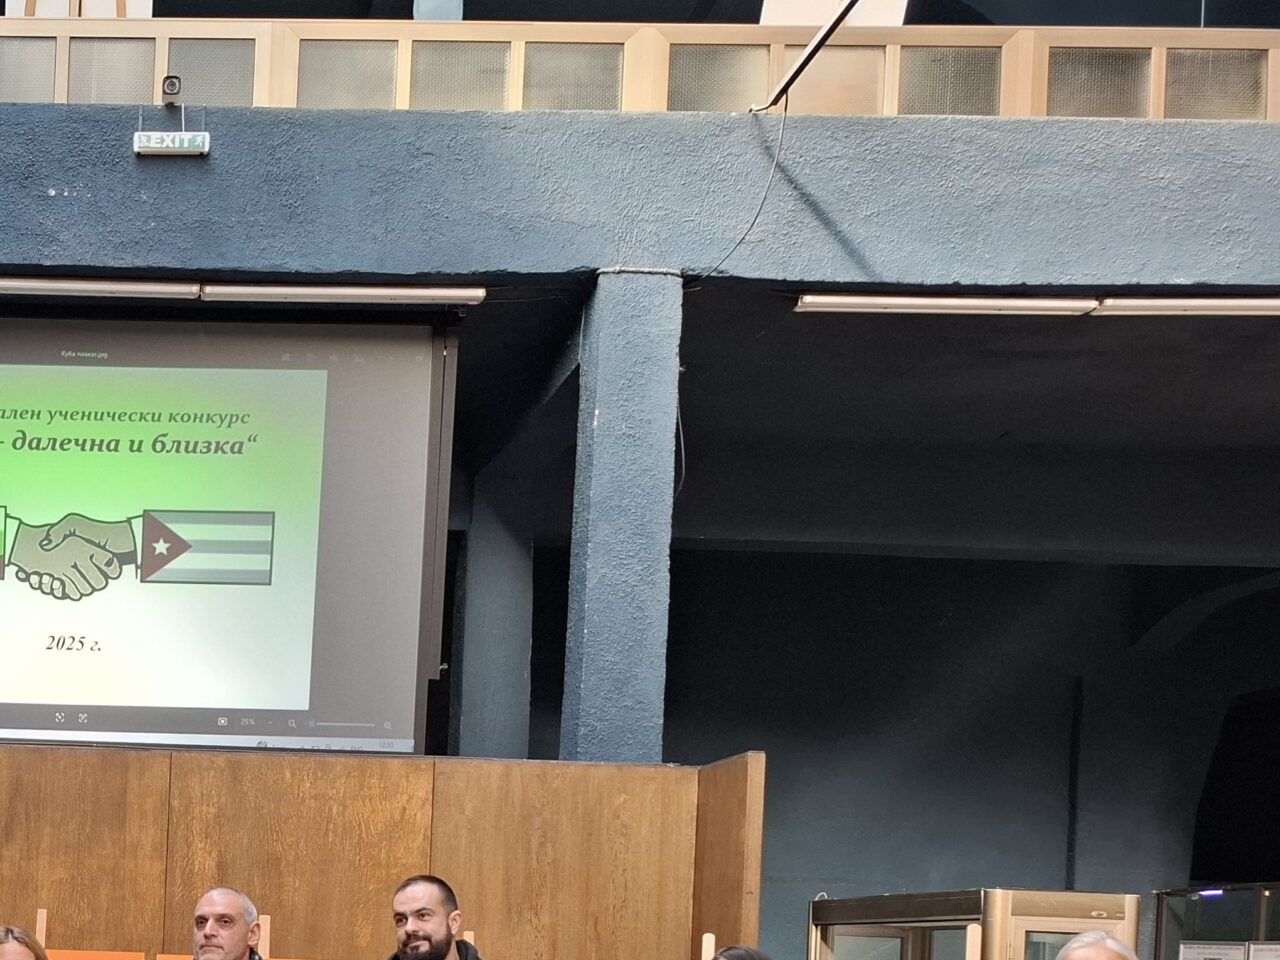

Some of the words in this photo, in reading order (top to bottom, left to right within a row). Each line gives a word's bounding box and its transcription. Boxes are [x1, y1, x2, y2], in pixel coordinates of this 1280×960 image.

[150, 134, 192, 148] EXIT
[46, 408, 162, 425] ученически
[168, 411, 251, 429] конкурс
[11, 429, 121, 453] далечна
[127, 438, 144, 454] и
[45, 635, 86, 651] 2025
[89, 640, 101, 651] г.
